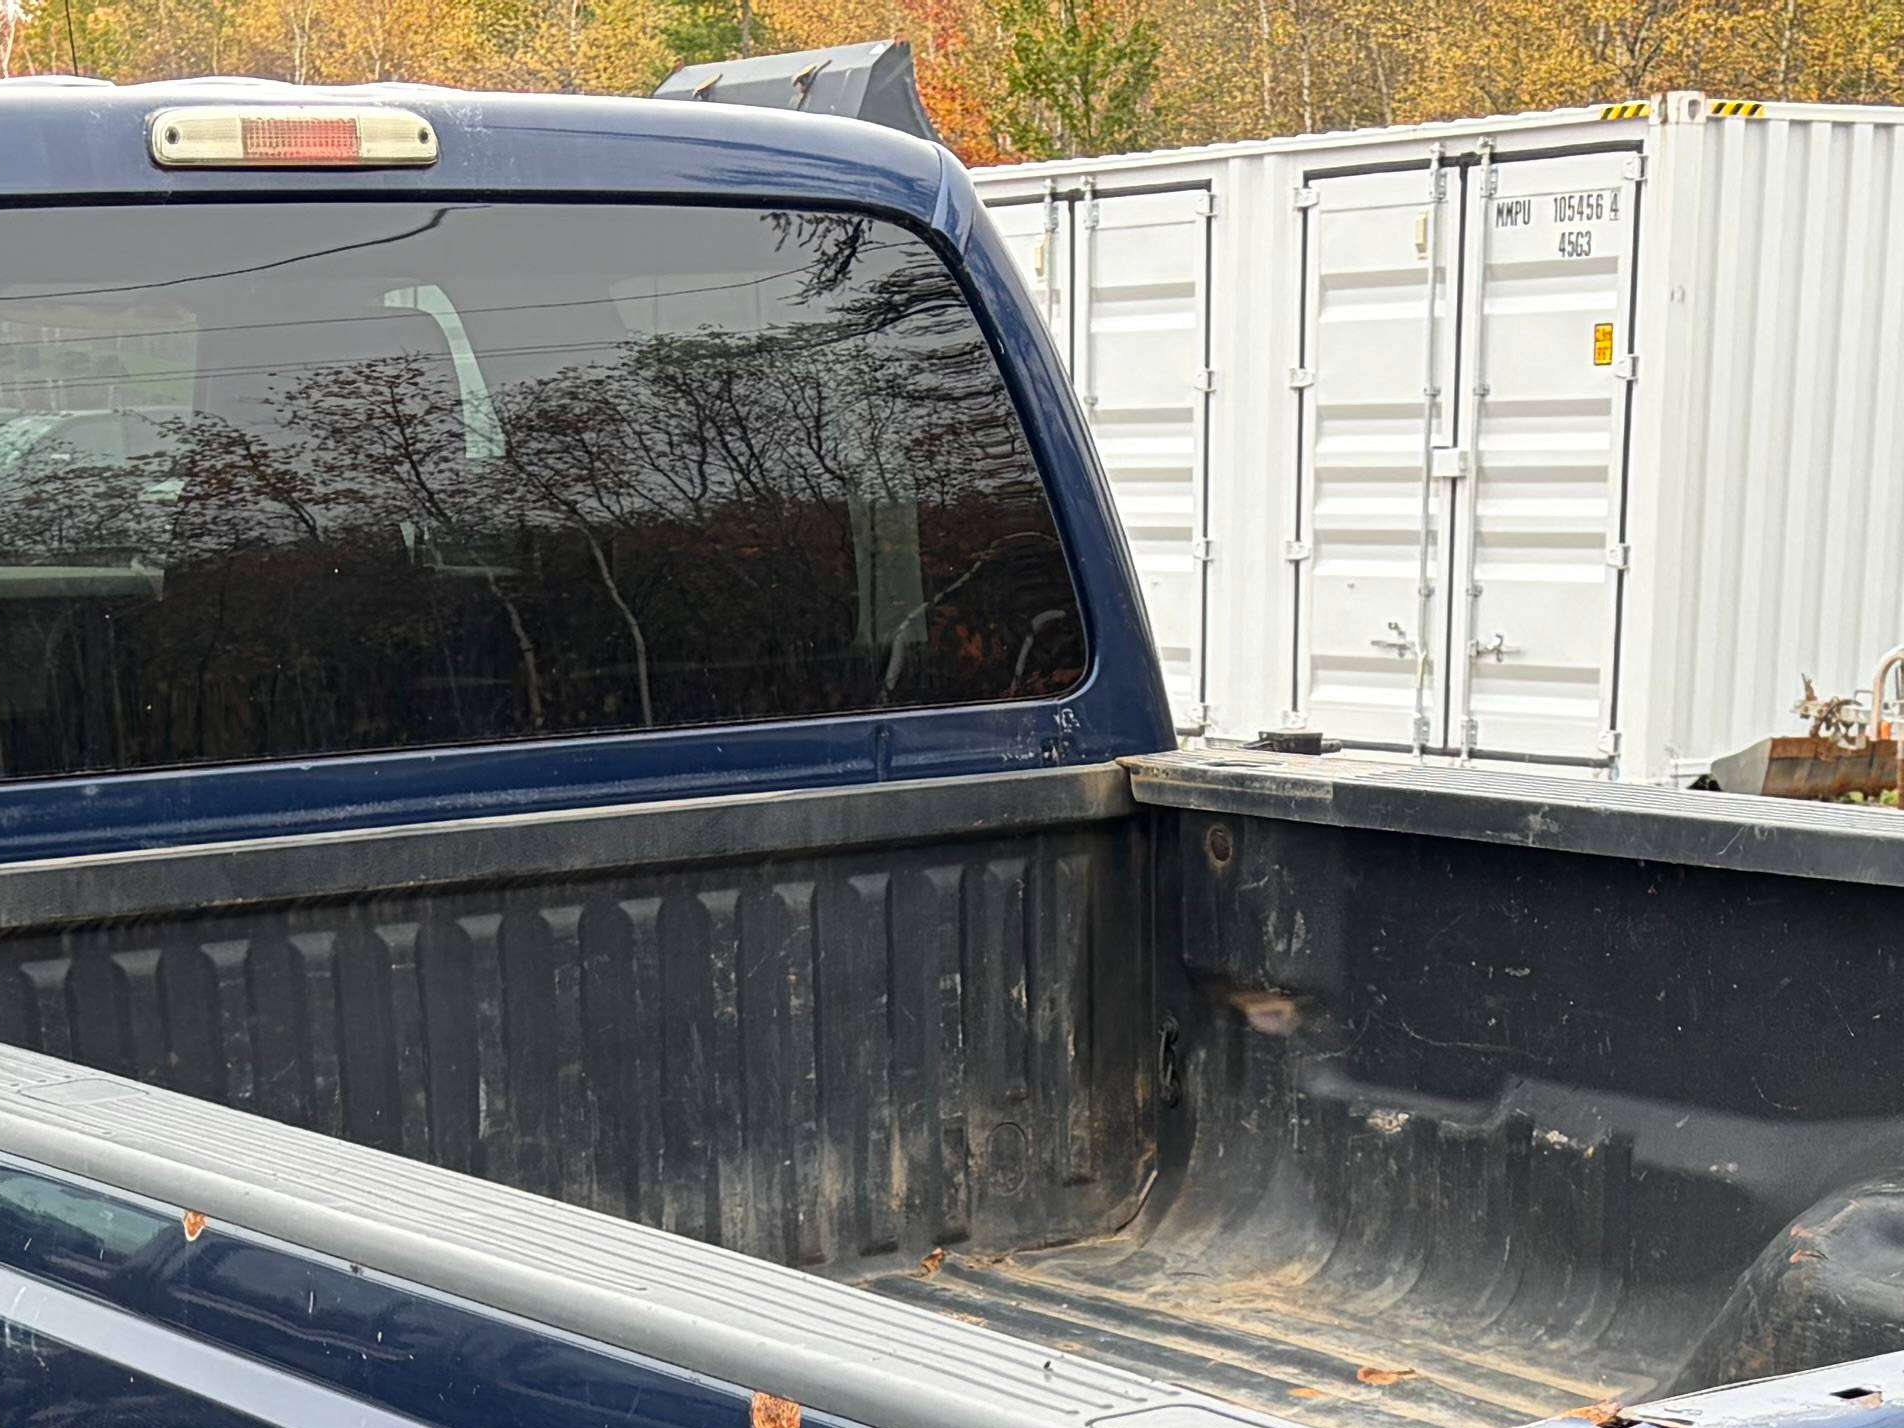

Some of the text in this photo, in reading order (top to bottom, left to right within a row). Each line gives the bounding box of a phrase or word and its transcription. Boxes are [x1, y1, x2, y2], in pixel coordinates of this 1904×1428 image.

[1495, 199, 1531, 228] MMPU
[1554, 193, 1604, 222] 105456
[1558, 230, 1592, 258] 45G3
